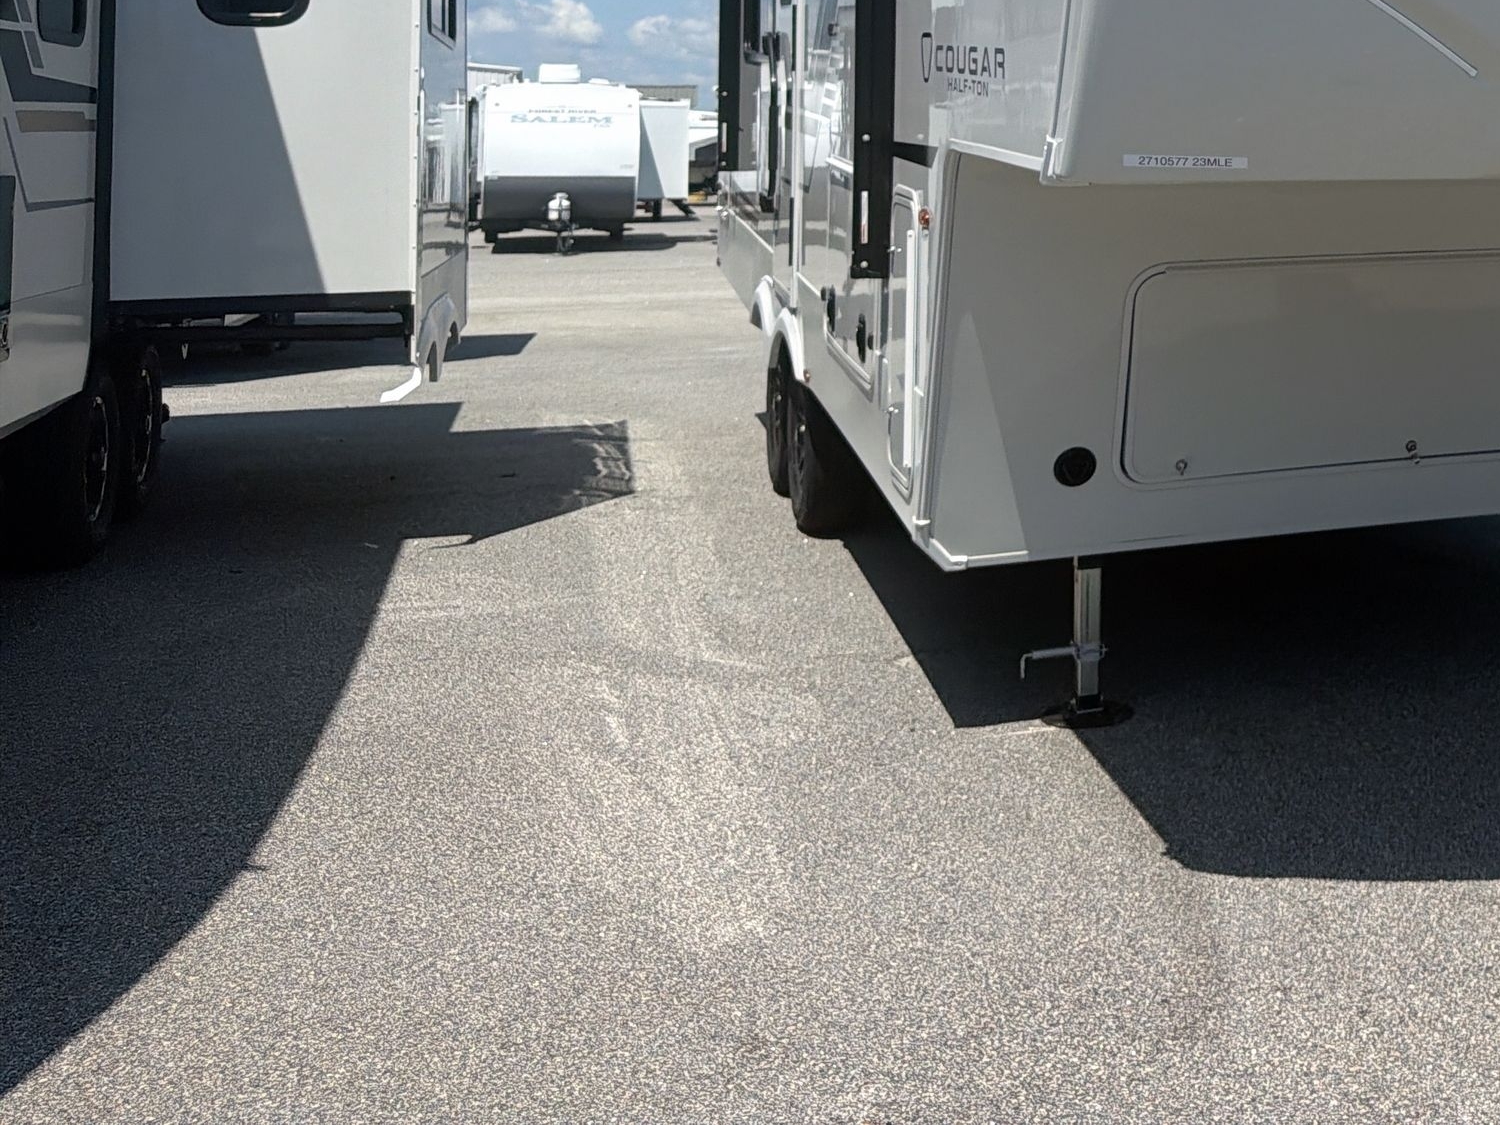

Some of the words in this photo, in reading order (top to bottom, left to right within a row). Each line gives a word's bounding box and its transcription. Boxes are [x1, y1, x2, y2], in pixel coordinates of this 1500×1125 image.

[935, 45, 1005, 79] COUGAR
[947, 76, 989, 97] HALF-TON
[510, 113, 613, 124] SALEM
[1138, 156, 1189, 167] 2710577
[1192, 157, 1233, 168] 23MLE
